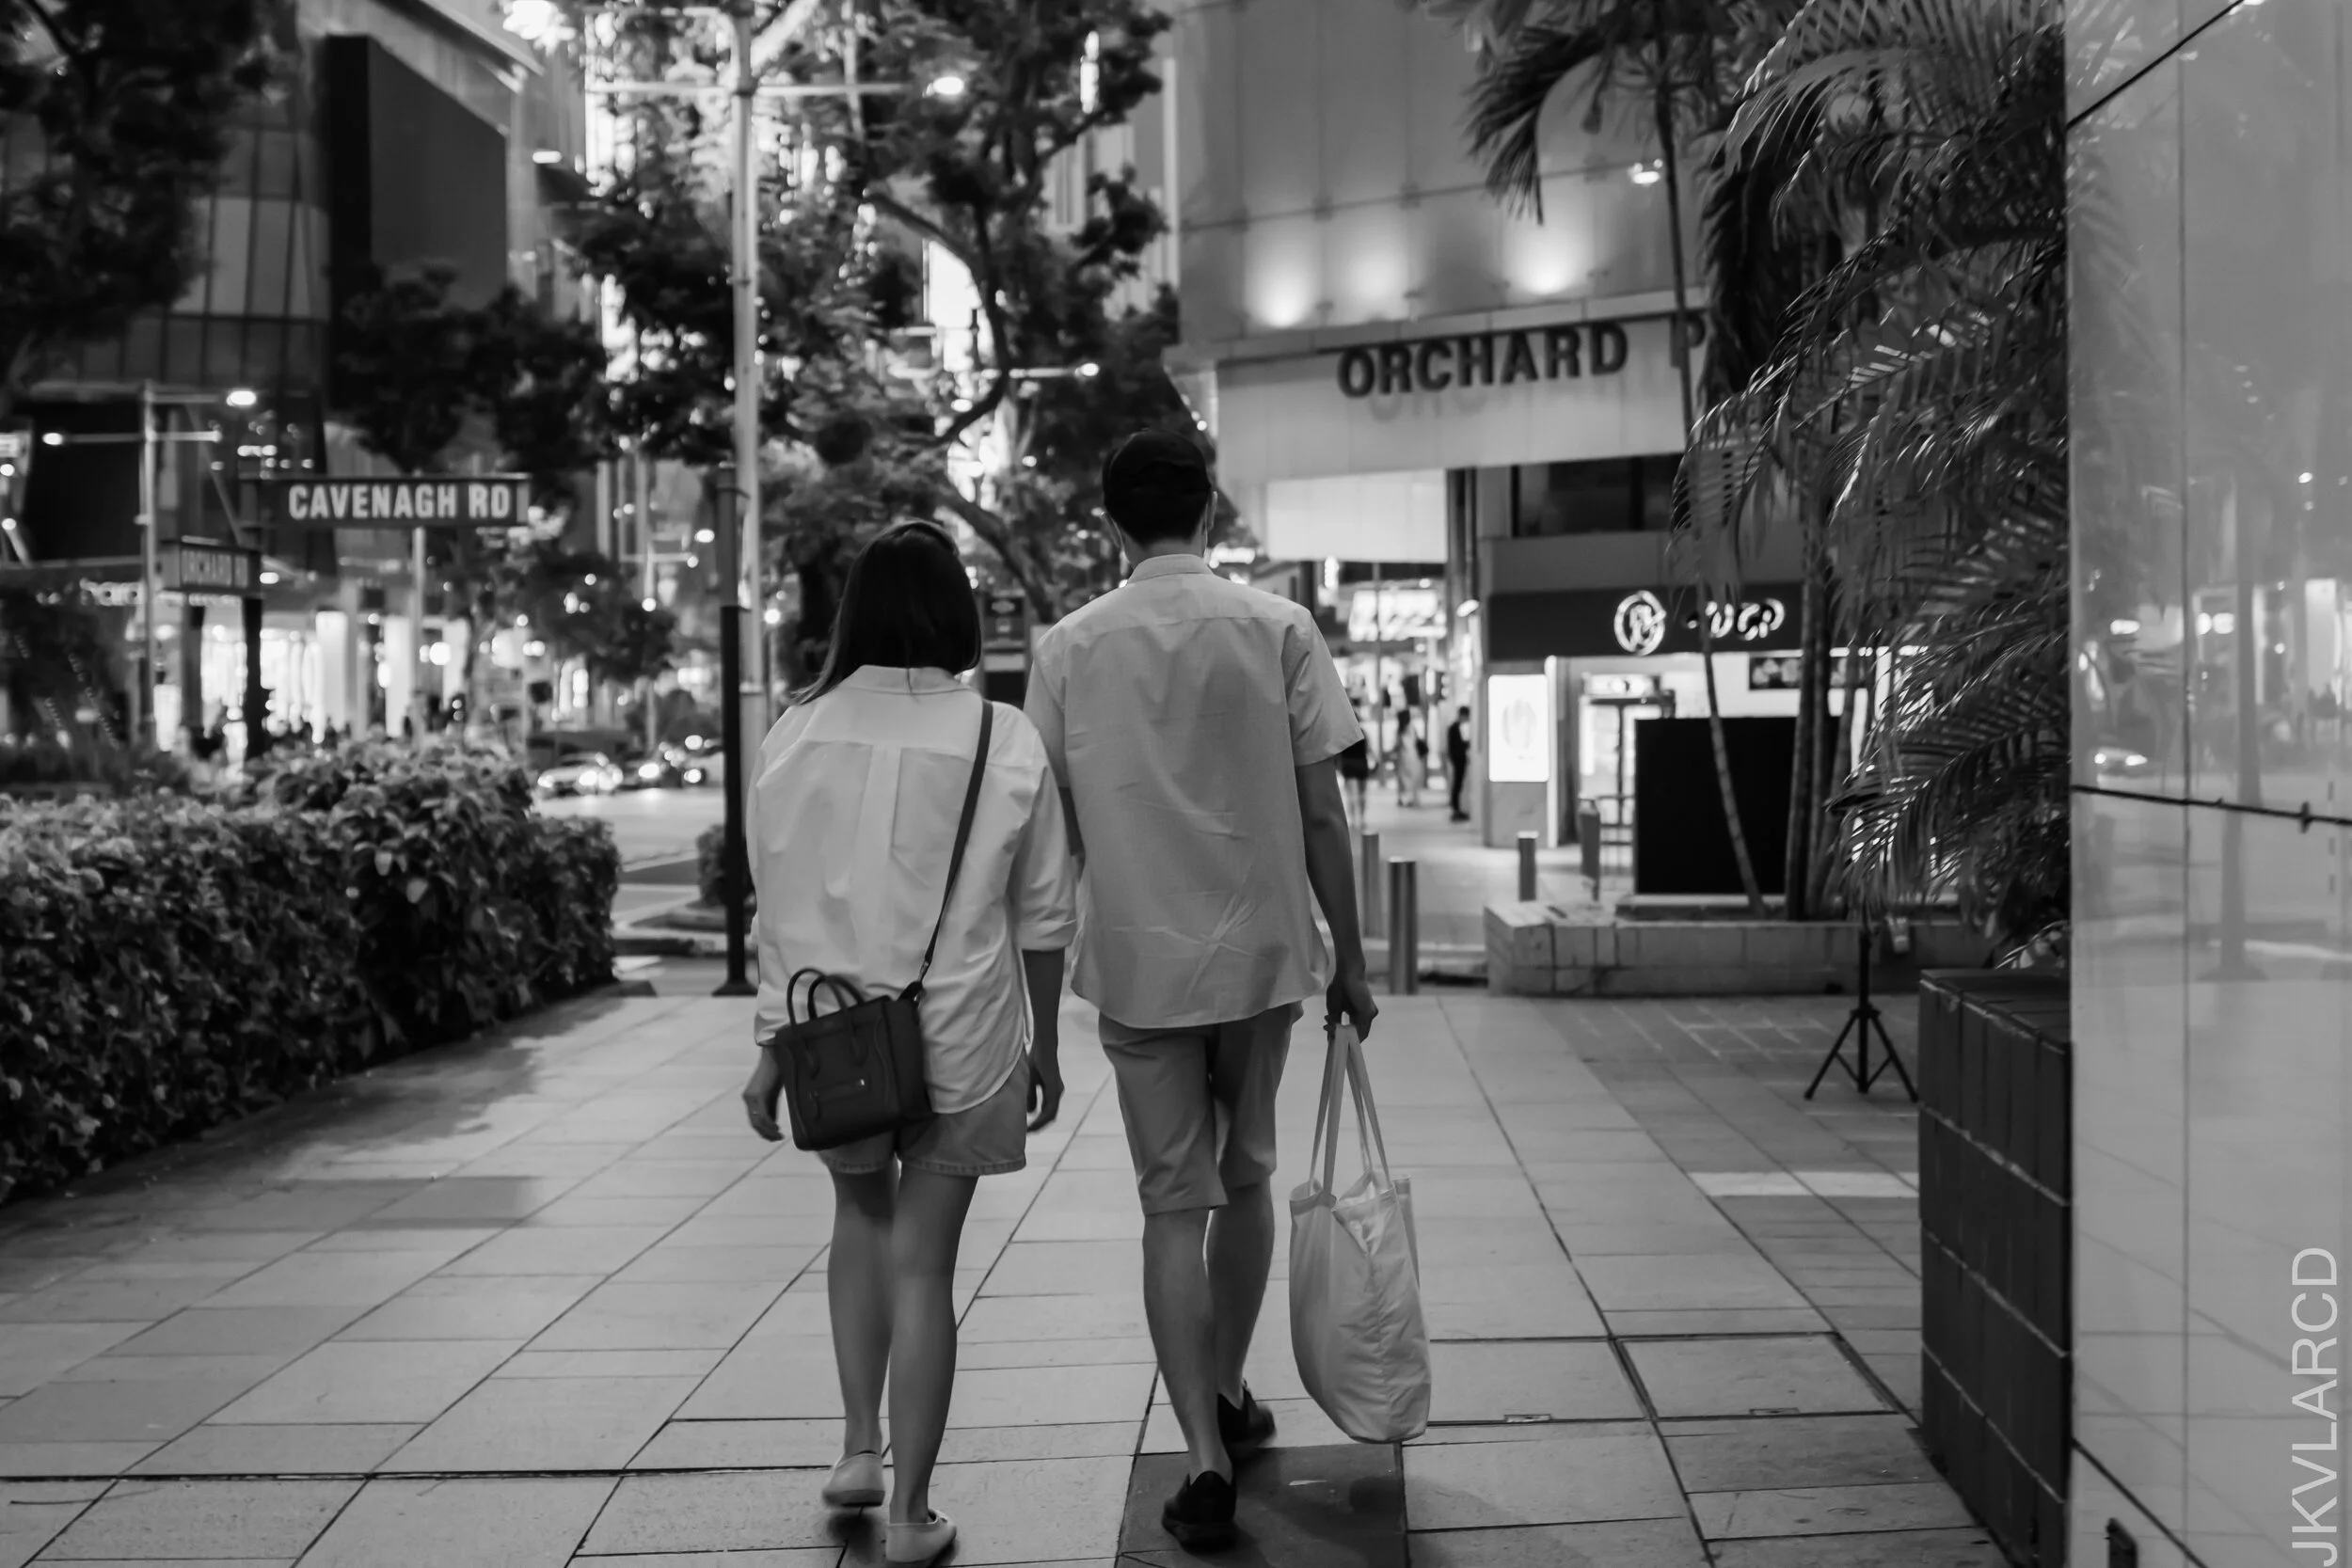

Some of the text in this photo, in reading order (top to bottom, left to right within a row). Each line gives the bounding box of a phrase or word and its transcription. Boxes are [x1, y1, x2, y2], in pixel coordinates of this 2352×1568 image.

[1337, 321, 1629, 399] ORCHARD
[288, 483, 511, 520] CAVENAGH RD
